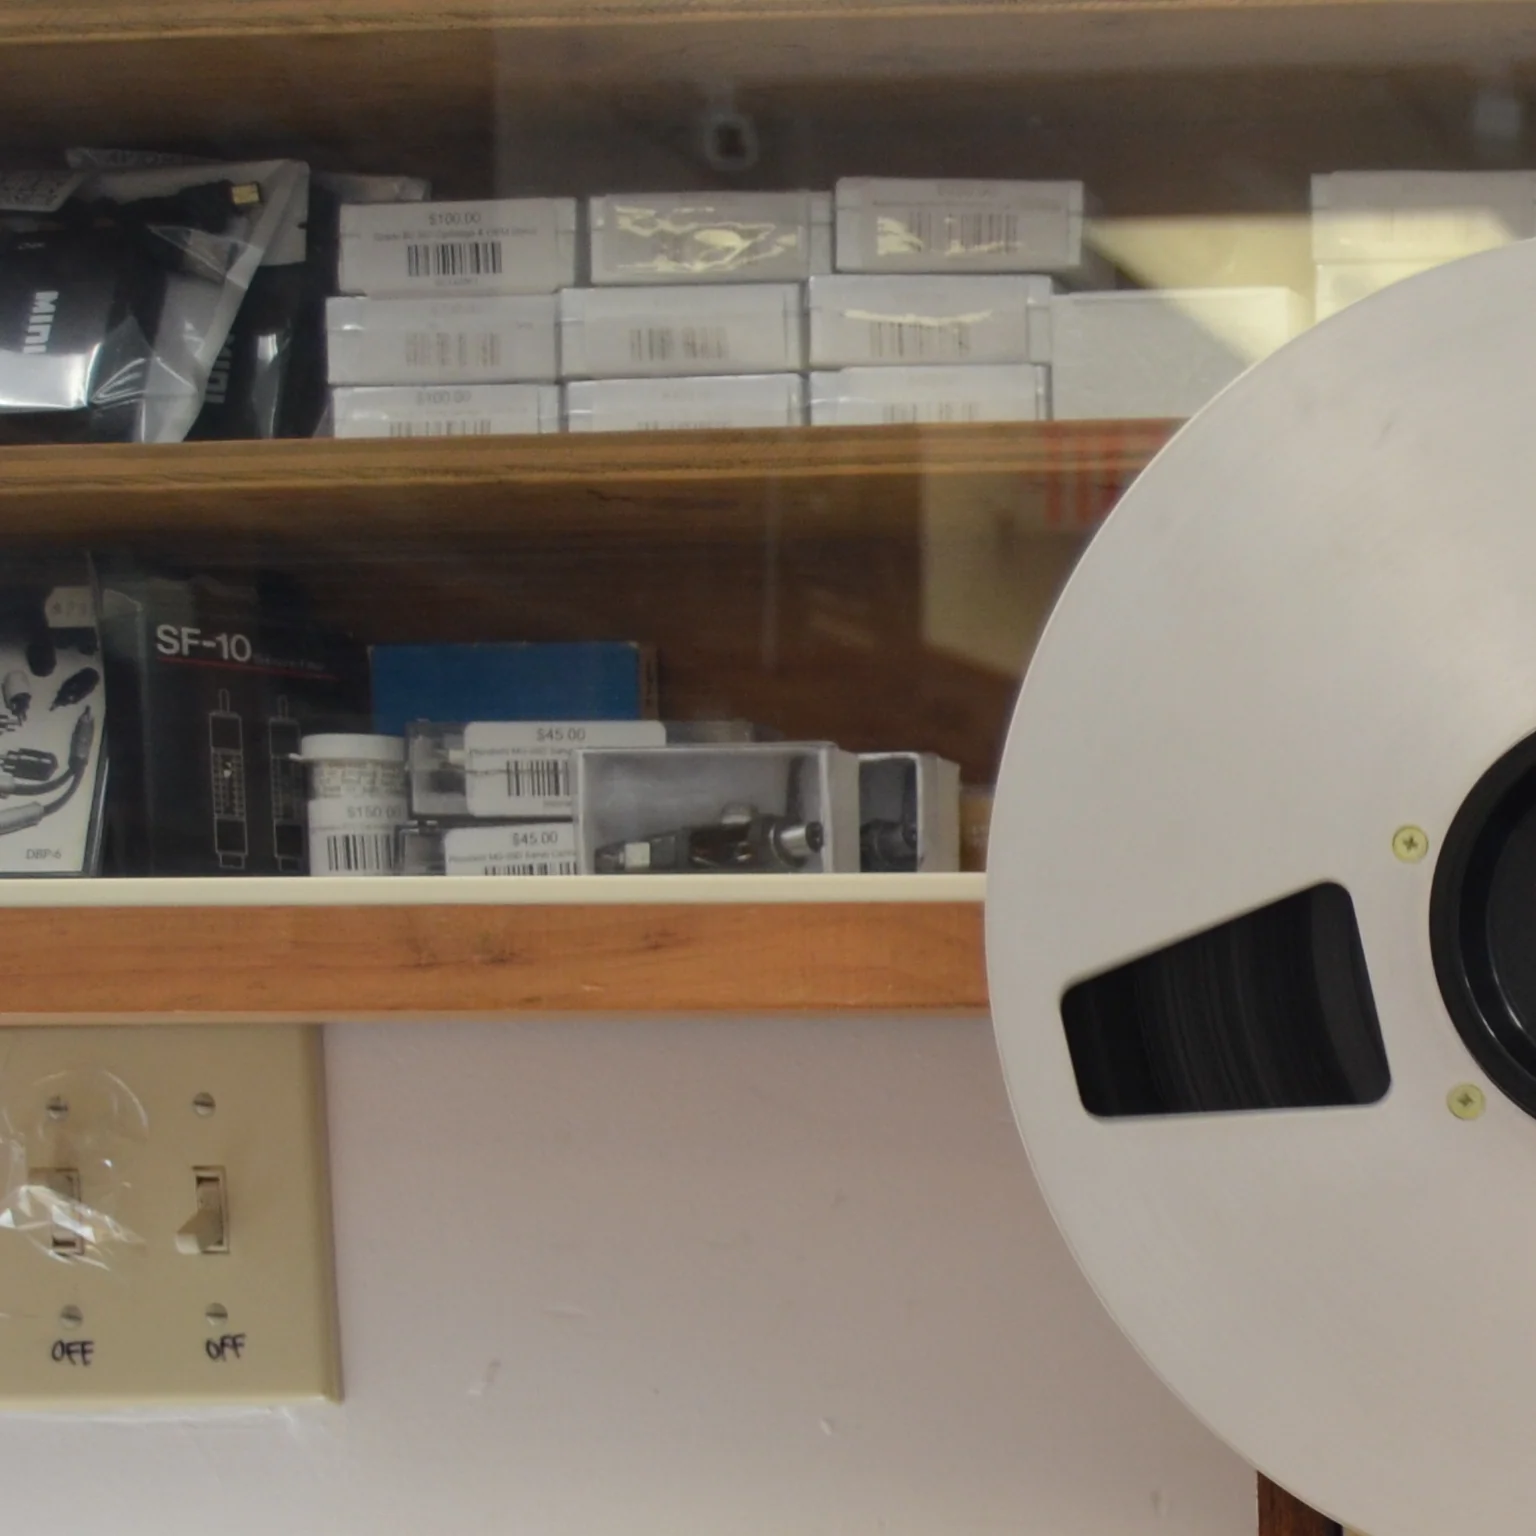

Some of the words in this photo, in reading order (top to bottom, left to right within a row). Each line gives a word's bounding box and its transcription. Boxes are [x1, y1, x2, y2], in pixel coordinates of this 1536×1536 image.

[156, 624, 252, 663] SF-10
[537, 728, 586, 742] $45.00
[51, 1340, 94, 1365] OFF
[205, 1333, 246, 1360] OFF
